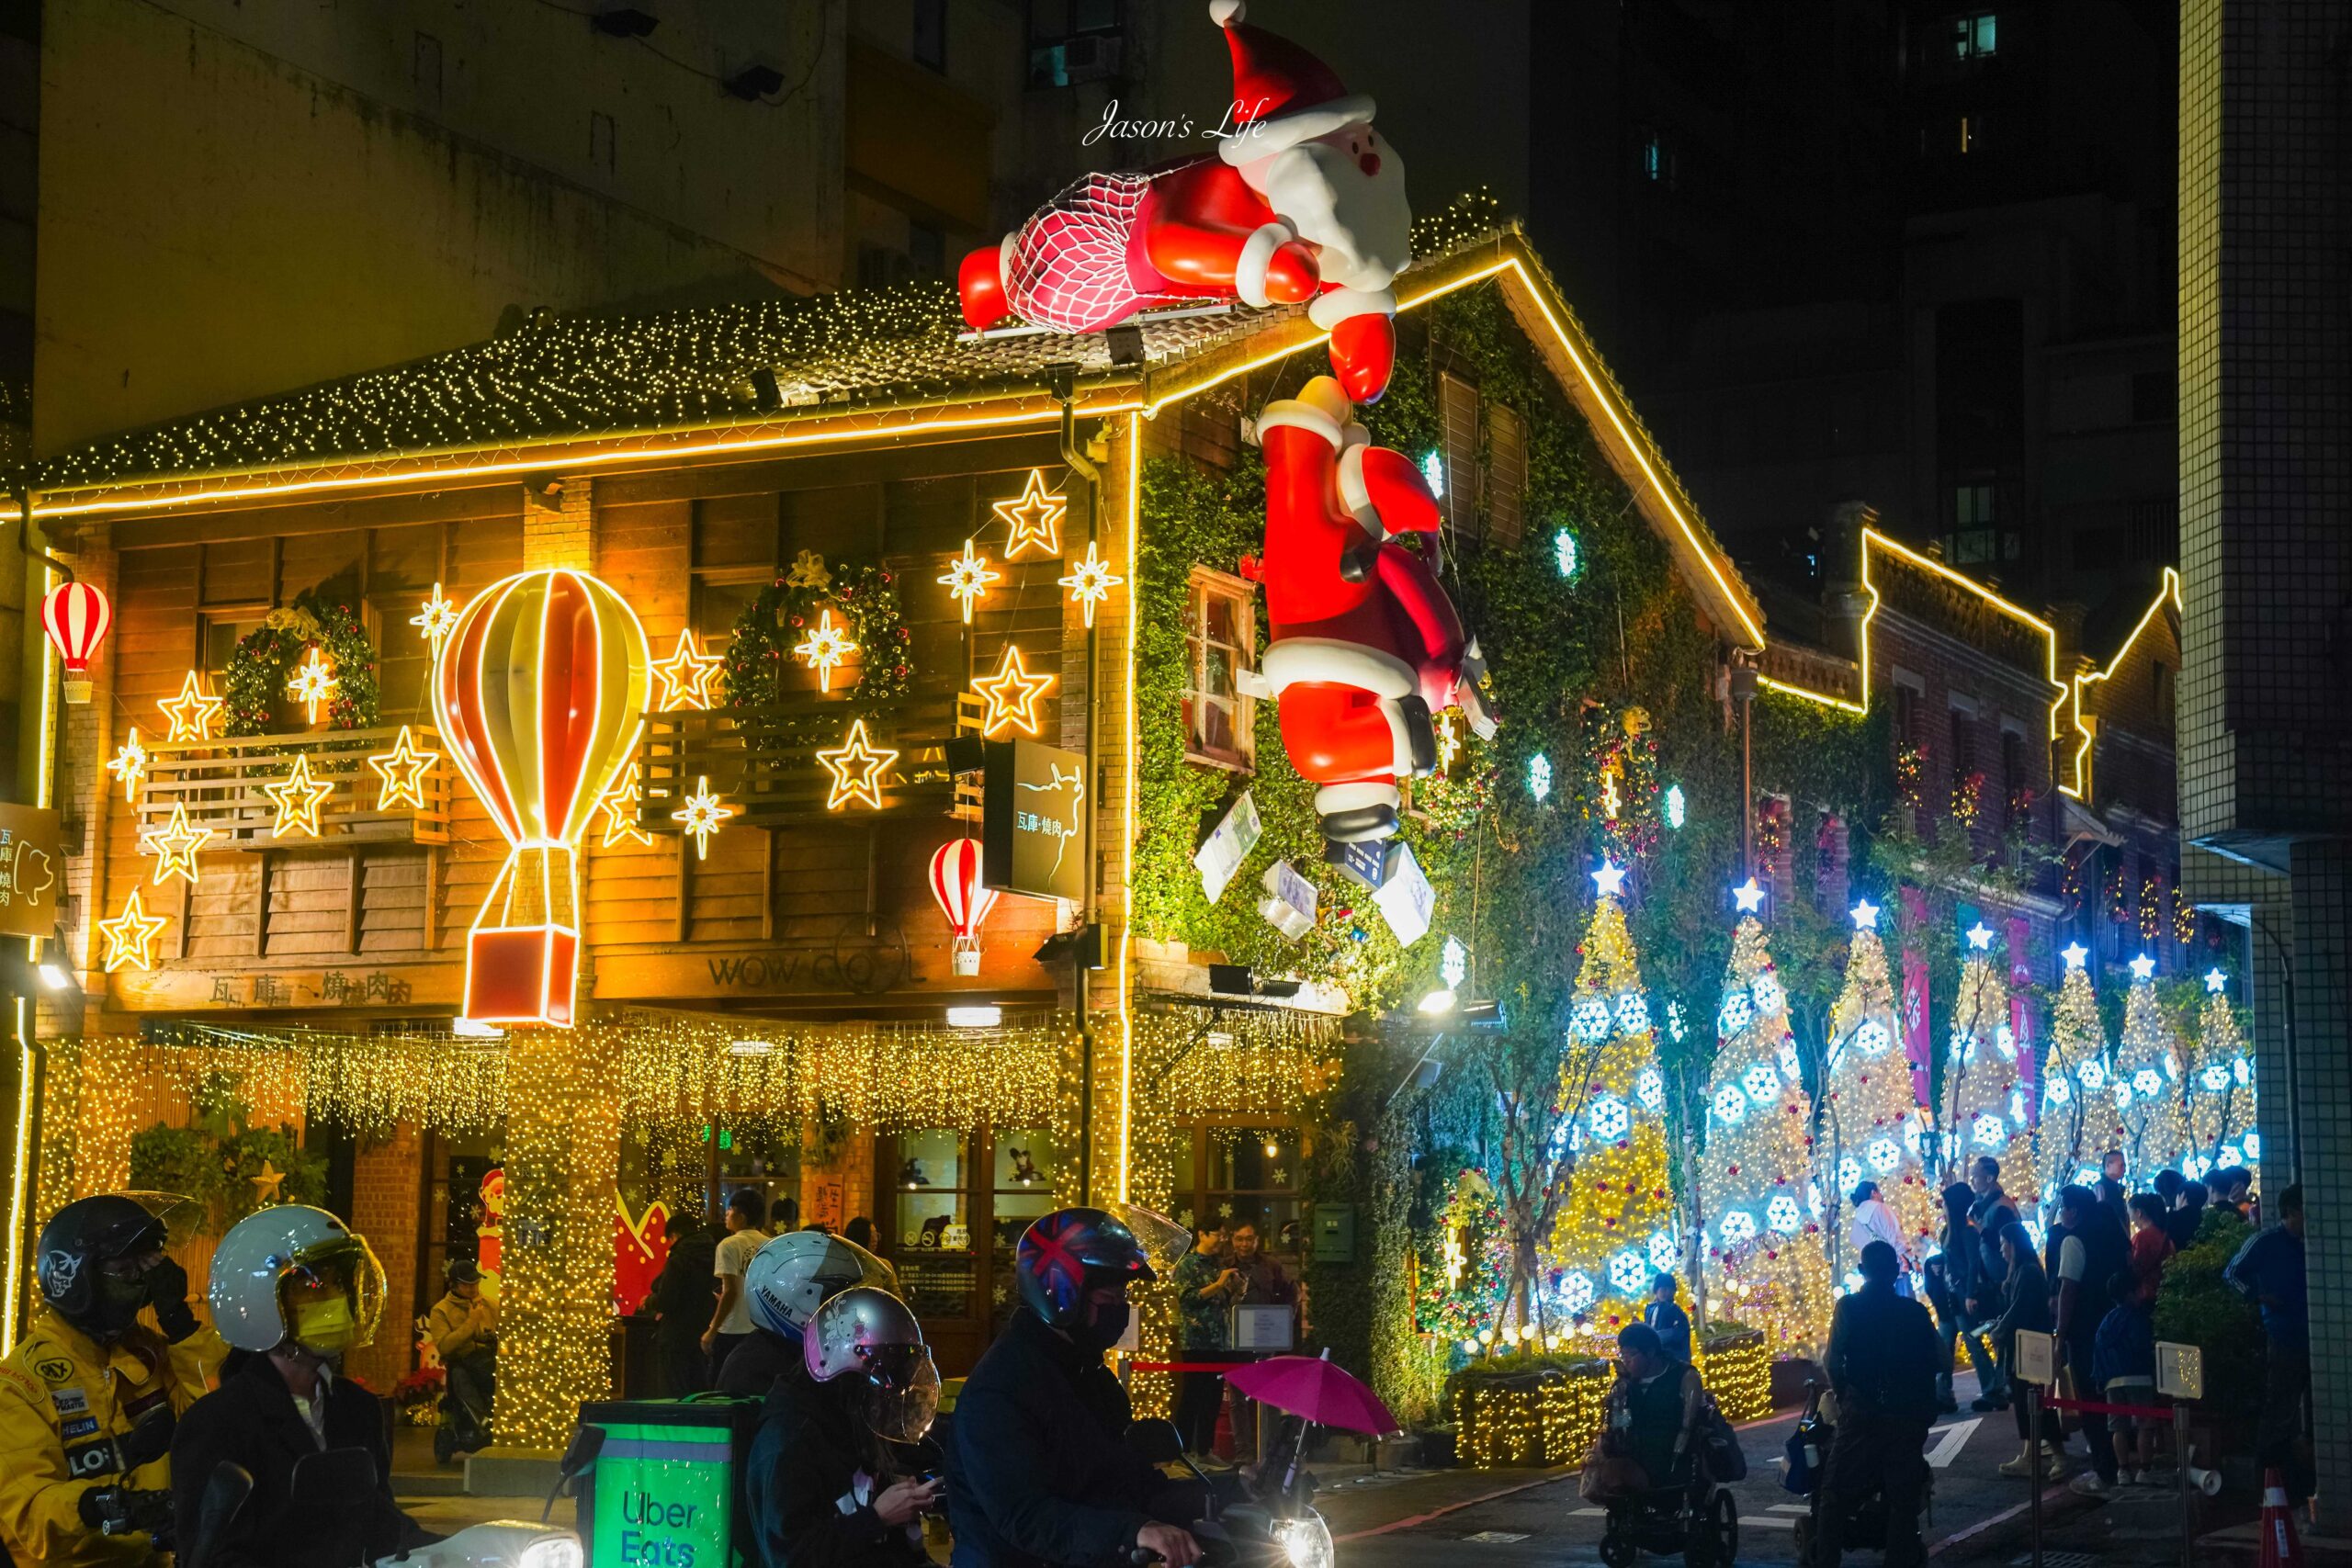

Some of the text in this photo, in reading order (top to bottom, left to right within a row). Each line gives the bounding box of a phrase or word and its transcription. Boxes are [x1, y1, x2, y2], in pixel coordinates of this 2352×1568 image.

[707, 955, 799, 987] WOW
[762, 1285, 793, 1318] YAMAHA
[623, 1491, 698, 1529] Uber
[621, 1530, 695, 1568] Eats
